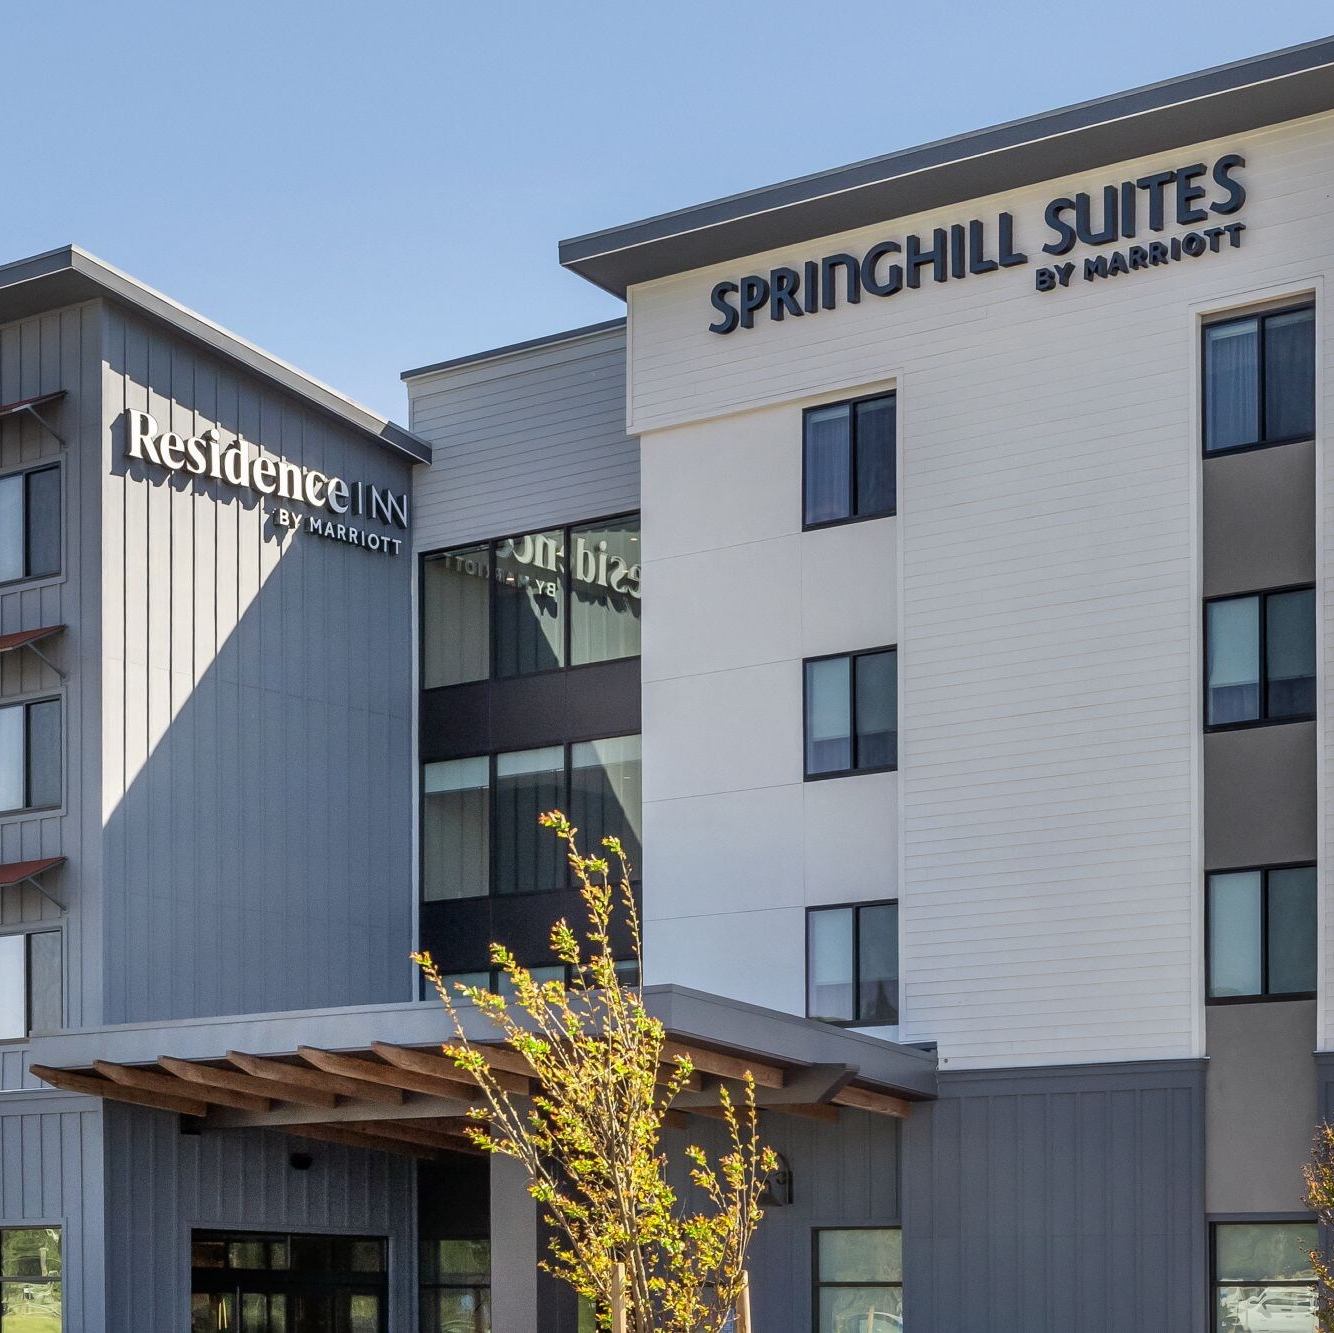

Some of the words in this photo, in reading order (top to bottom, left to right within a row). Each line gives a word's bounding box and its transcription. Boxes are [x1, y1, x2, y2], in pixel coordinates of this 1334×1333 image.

[709, 211, 1028, 335] SPRINGHILL
[1042, 154, 1246, 256] SUITES
[1036, 262, 1075, 292] BY
[1084, 222, 1246, 282] MARRIOTT
[126, 408, 349, 514] Residence
[354, 481, 407, 528] INN
[277, 508, 302, 528] BY
[307, 517, 402, 555] MARRIOTT
